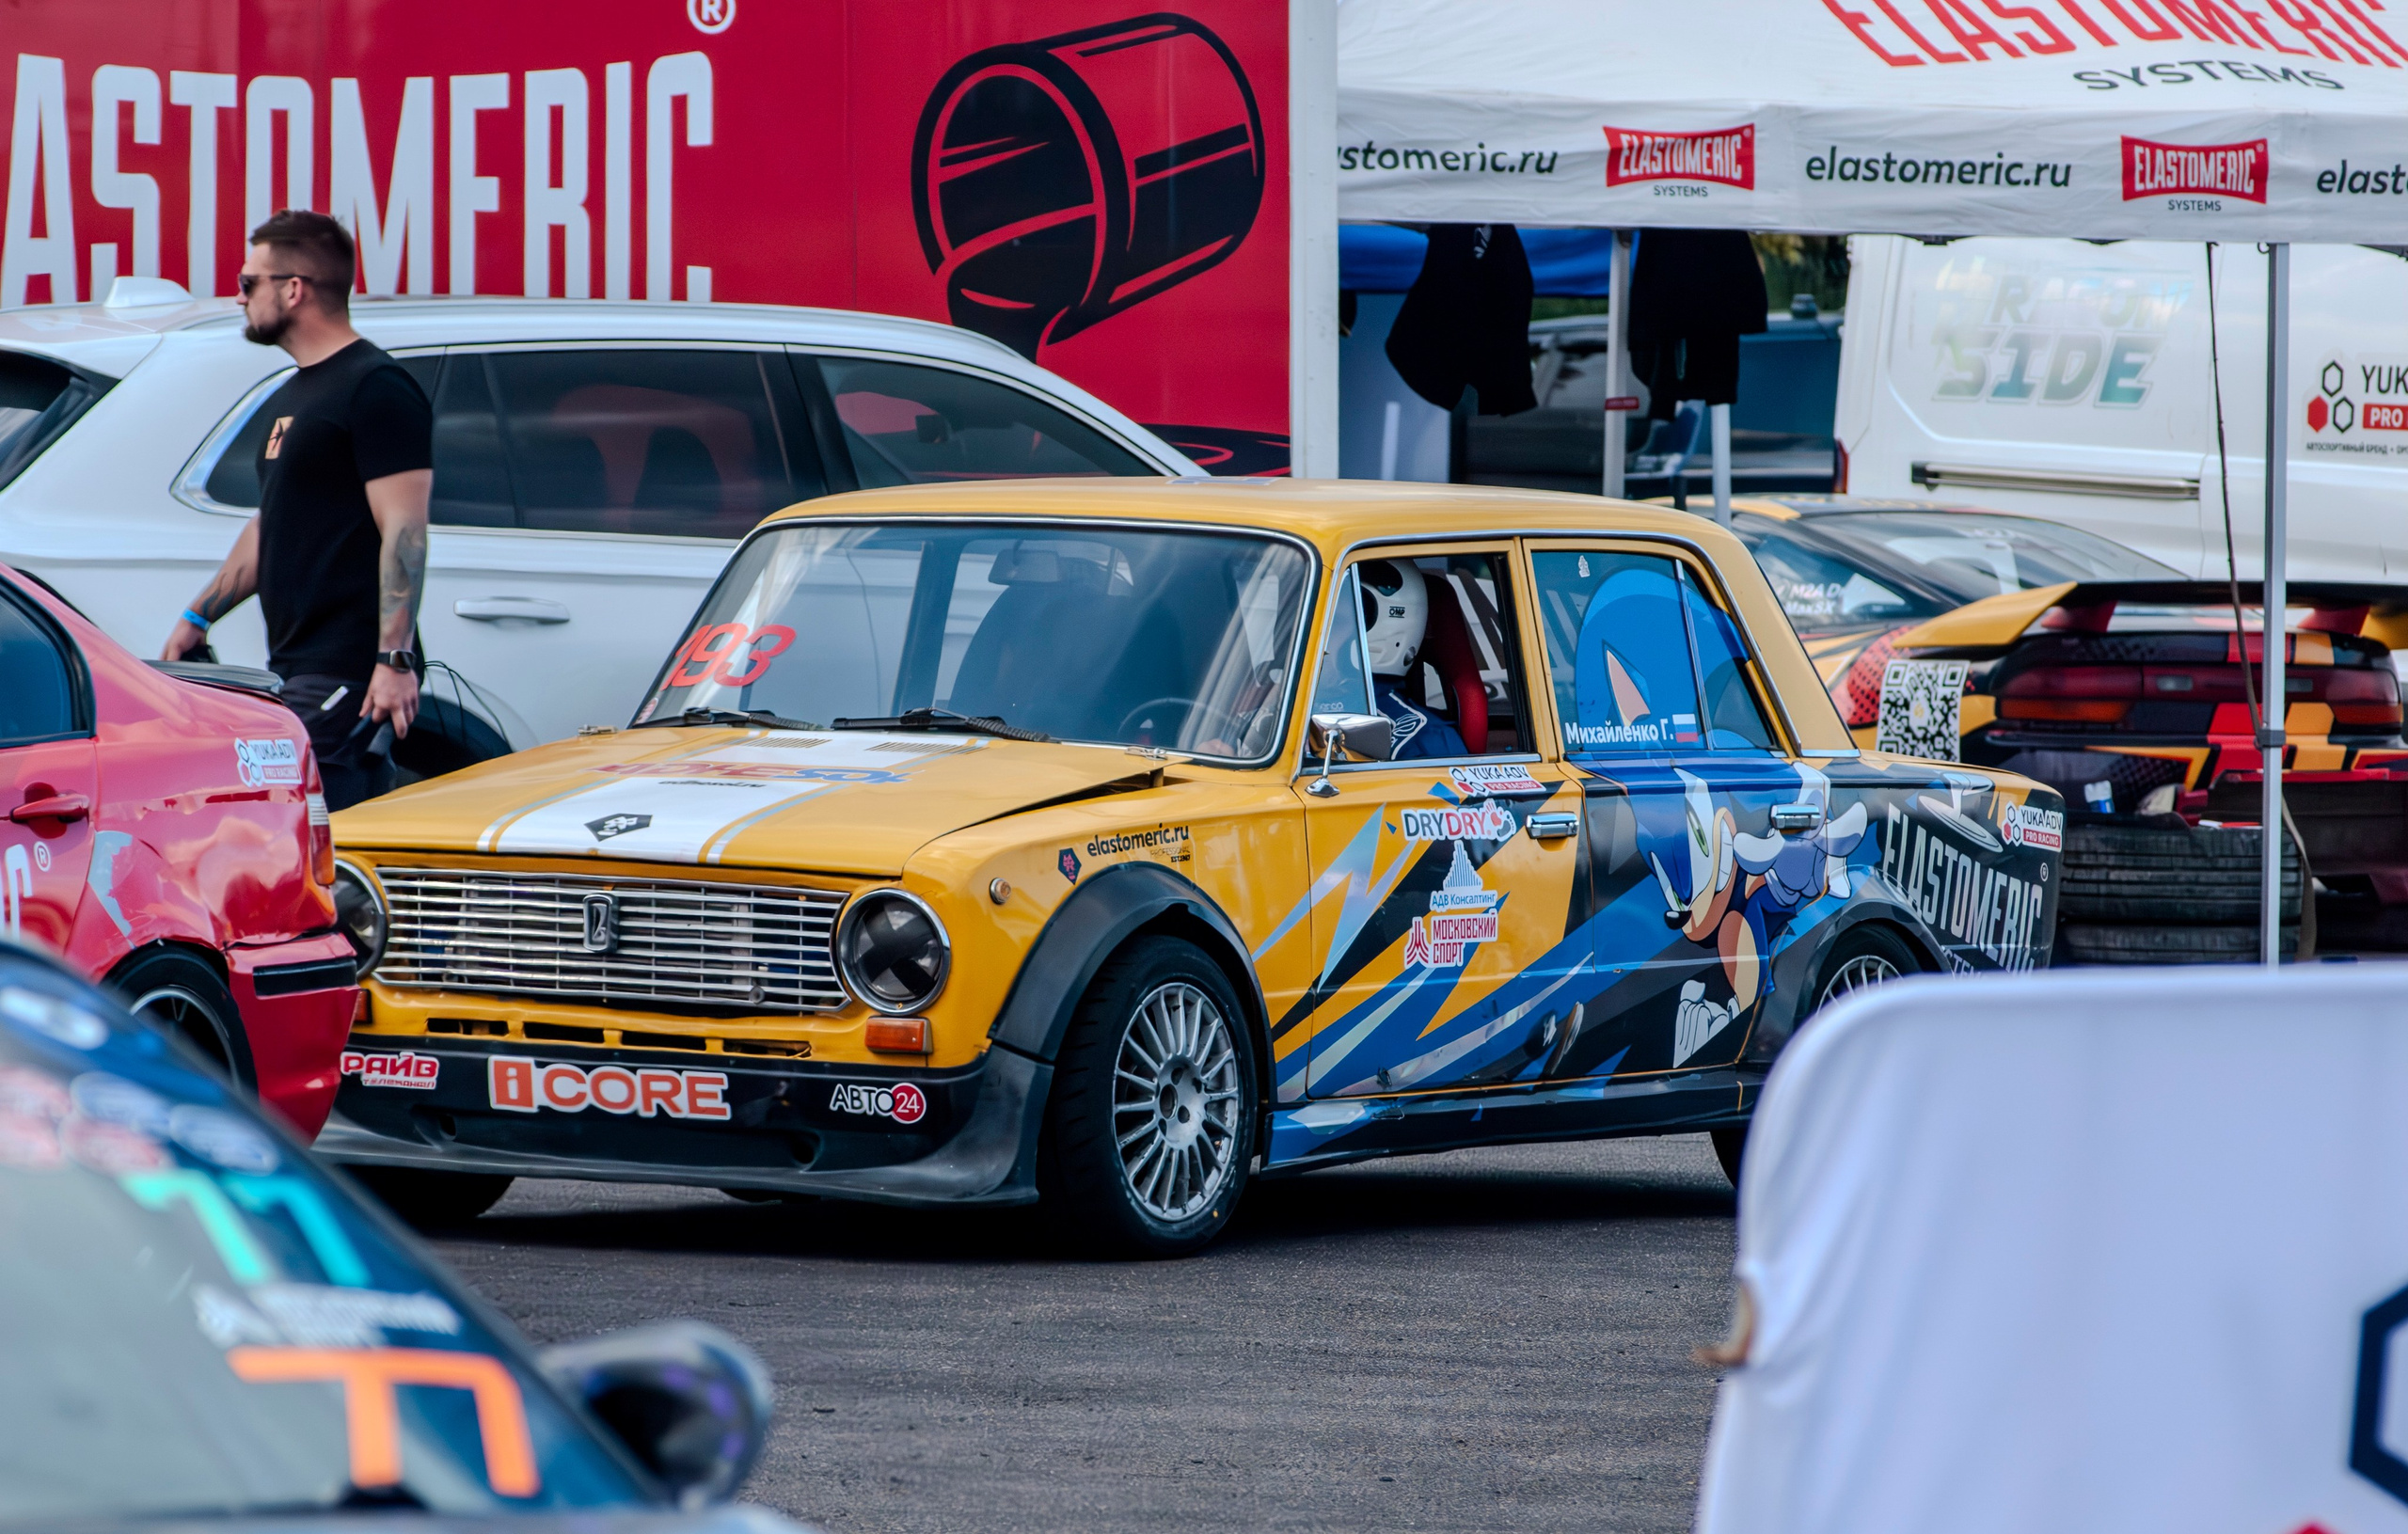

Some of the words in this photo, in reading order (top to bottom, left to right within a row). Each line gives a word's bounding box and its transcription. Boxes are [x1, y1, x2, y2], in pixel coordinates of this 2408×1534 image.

[2073, 60, 2345, 90] SYSTEMS
[1337, 140, 1558, 175] stomeric.ru
[1619, 132, 1742, 179] ELASTOMERIC
[1806, 147, 2072, 188] elastomeric.ru
[2134, 145, 2256, 192] ELASTOMERIC
[2317, 159, 2408, 195] elast
[1653, 185, 1708, 198] SYSTEMS
[2167, 199, 2223, 212] SYSTEMS
[2361, 364, 2408, 394] YUK
[2369, 406, 2404, 428] PRO
[1388, 607, 1405, 617] OMP
[661, 623, 797, 690] 193
[1564, 720, 1659, 746] Михайленко
[1660, 719, 1674, 741] Г.
[1468, 767, 1503, 780] YUKA
[1504, 766, 1529, 779] ADV
[1507, 782, 1538, 790] RACING
[2020, 809, 2045, 828] YUKA
[2045, 813, 2062, 830] ADV
[1087, 823, 1189, 857] elastomeric.ru
[2025, 830, 2037, 843] PRO
[2037, 832, 2059, 846] RACING
[1432, 894, 1450, 908] АДВ
[1450, 893, 1496, 906] Консалтинг
[1882, 802, 2043, 974] ELASTOMERIC
[1433, 912, 1497, 941] МОСКОВСКИЙ
[1433, 941, 1464, 964] СПОРТ
